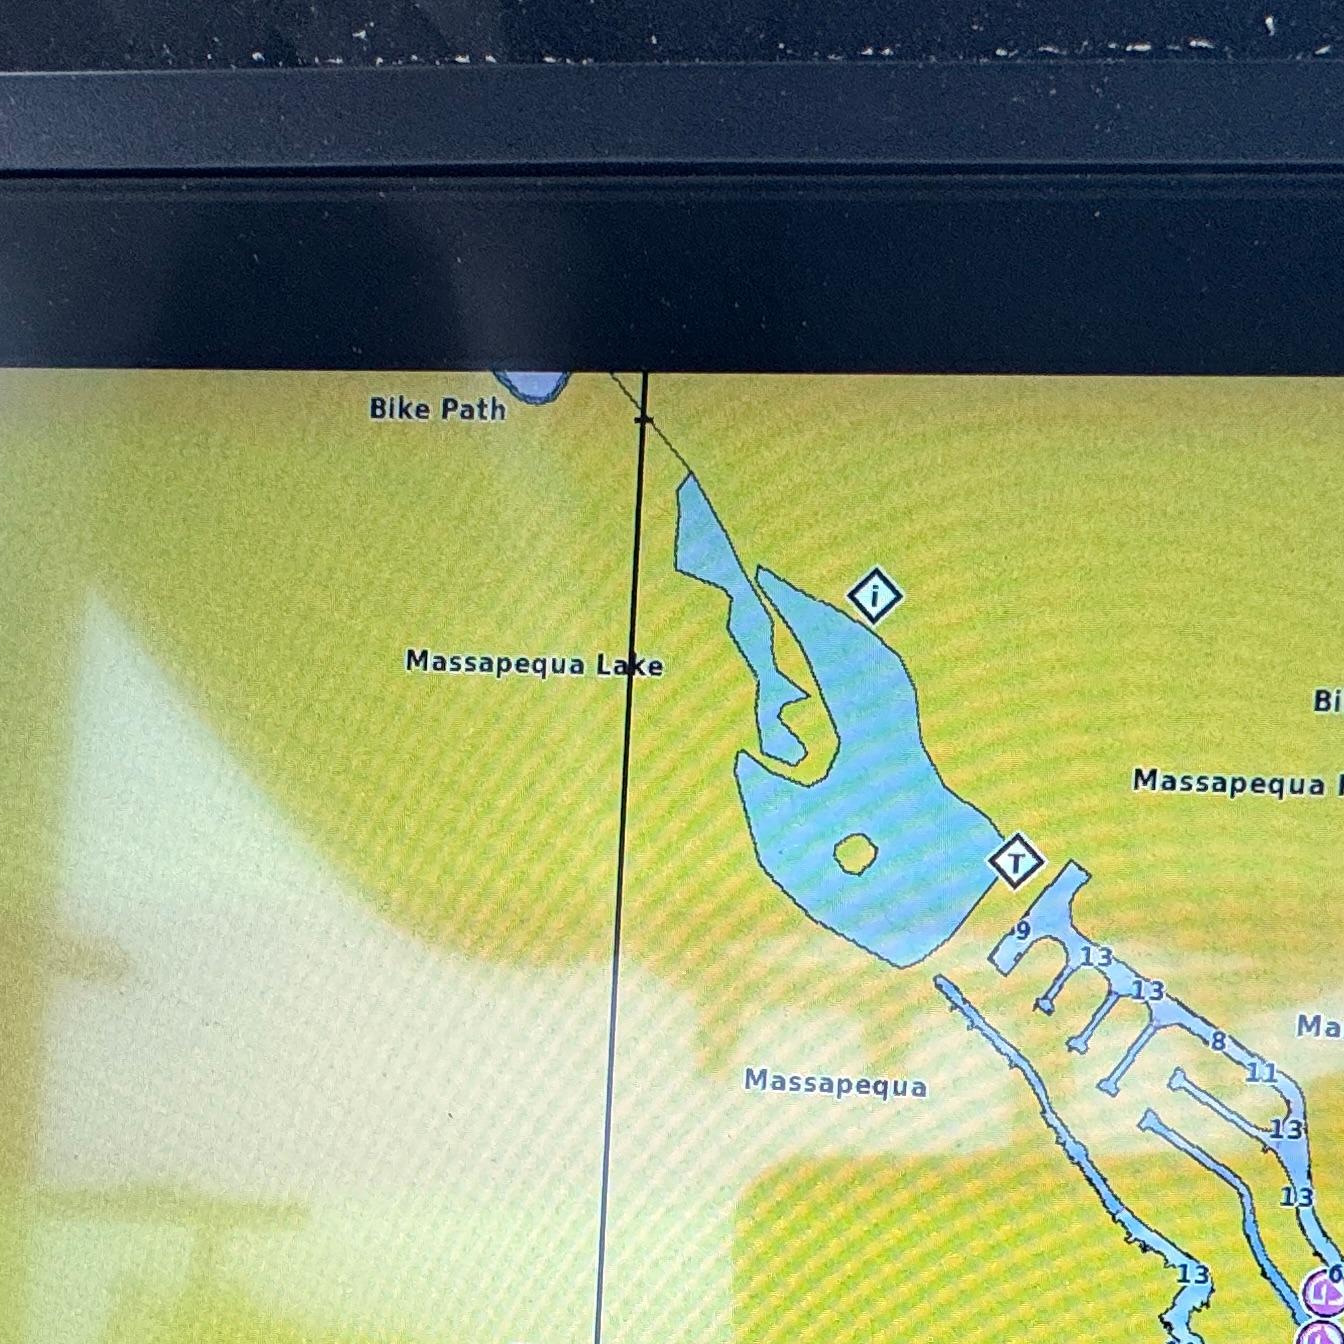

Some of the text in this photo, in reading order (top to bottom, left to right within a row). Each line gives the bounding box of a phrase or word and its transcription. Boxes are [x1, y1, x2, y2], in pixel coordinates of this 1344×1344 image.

[369, 396, 507, 423] Bike Path
[405, 647, 664, 679] Massapequa Lake
[1133, 768, 1325, 800] Massapequa
[1016, 921, 1031, 940] 9
[1080, 946, 1113, 967] 13
[1133, 980, 1165, 1000] 13
[1211, 1032, 1226, 1052] 8
[1247, 1063, 1278, 1083] 11
[745, 1067, 928, 1101] Massapequa
[1270, 1119, 1305, 1140] 13
[1281, 1187, 1314, 1207] 13
[1177, 1264, 1209, 1284] 13
[1328, 1264, 1344, 1284] 6
